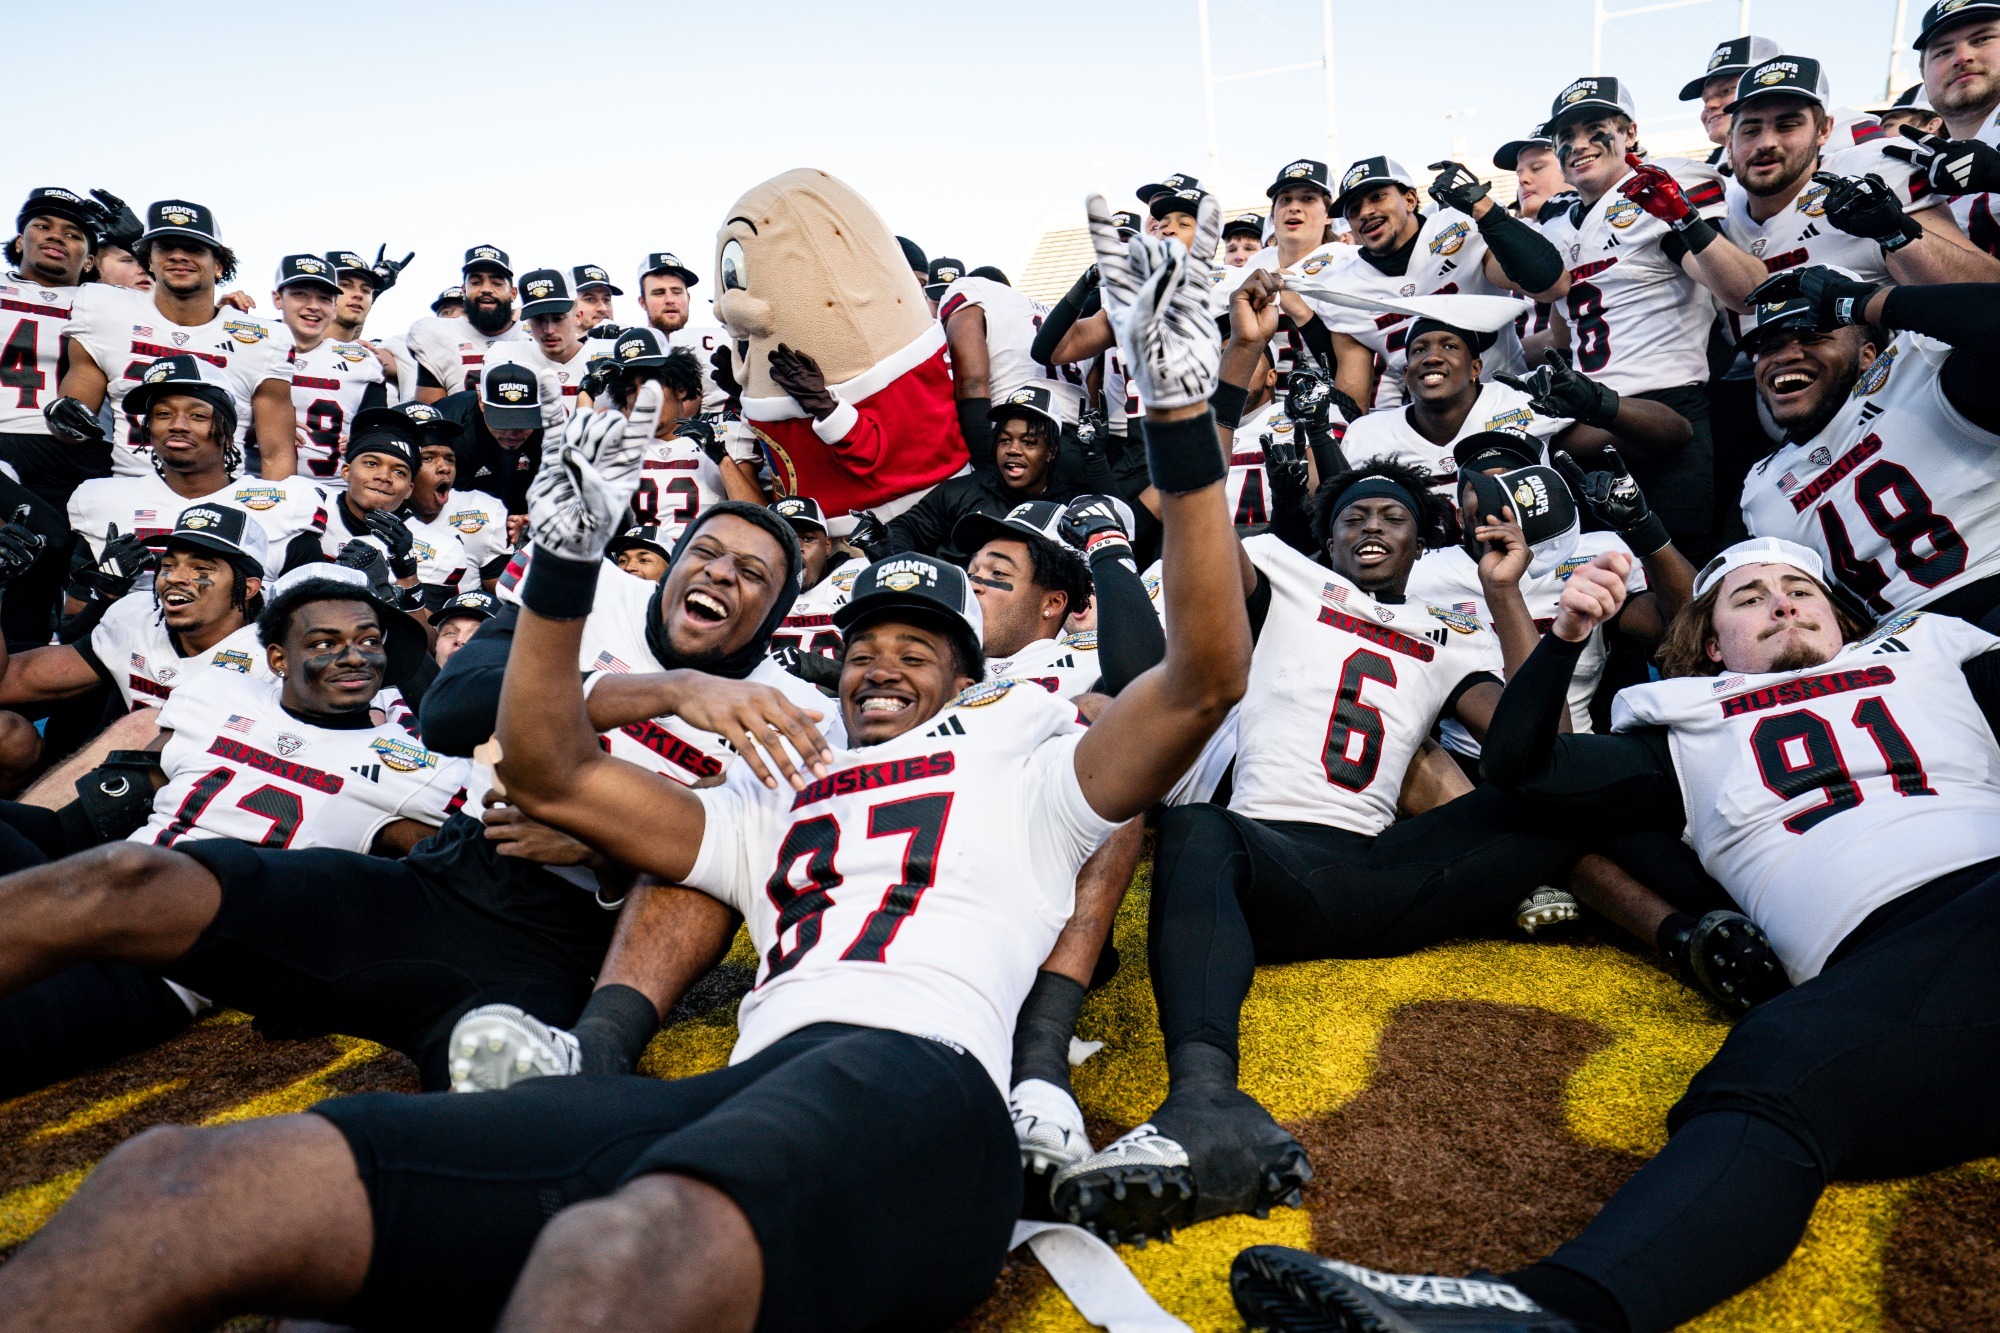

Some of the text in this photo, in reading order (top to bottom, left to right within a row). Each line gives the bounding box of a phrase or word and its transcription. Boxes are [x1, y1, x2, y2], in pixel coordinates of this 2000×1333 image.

[1754, 62, 1799, 79] CHAMPS
[1561, 80, 1598, 101] CHAMPS
[161, 205, 198, 219] CHAMPS
[526, 280, 555, 291] CHAMPS
[1566, 280, 1611, 373] 8
[619, 340, 645, 354] CHAMPS
[702, 335, 715, 351] C
[498, 383, 529, 393] CHAMPS
[405, 404, 436, 415] CHAMPS
[1506, 408, 1532, 424] POTATO
[1790, 432, 1884, 515] HUSKIES
[777, 500, 805, 511] CHAMPS
[1525, 475, 1549, 516] CHAMPS
[182, 508, 222, 524] CHAMPS
[1817, 458, 1969, 617] 48
[876, 560, 938, 581] CHAMPS
[456, 592, 492, 605] CHAMPS
[1317, 604, 1436, 663] HUSKIES
[1720, 665, 1897, 719] HUSKIES
[1320, 647, 1398, 793] 6
[620, 719, 723, 779] SKIES
[206, 735, 345, 795] HUSKIES
[383, 753, 417, 769] BOWL
[1749, 695, 1939, 835] 91
[789, 750, 956, 813] HUSKIES
[753, 792, 955, 992] 87
